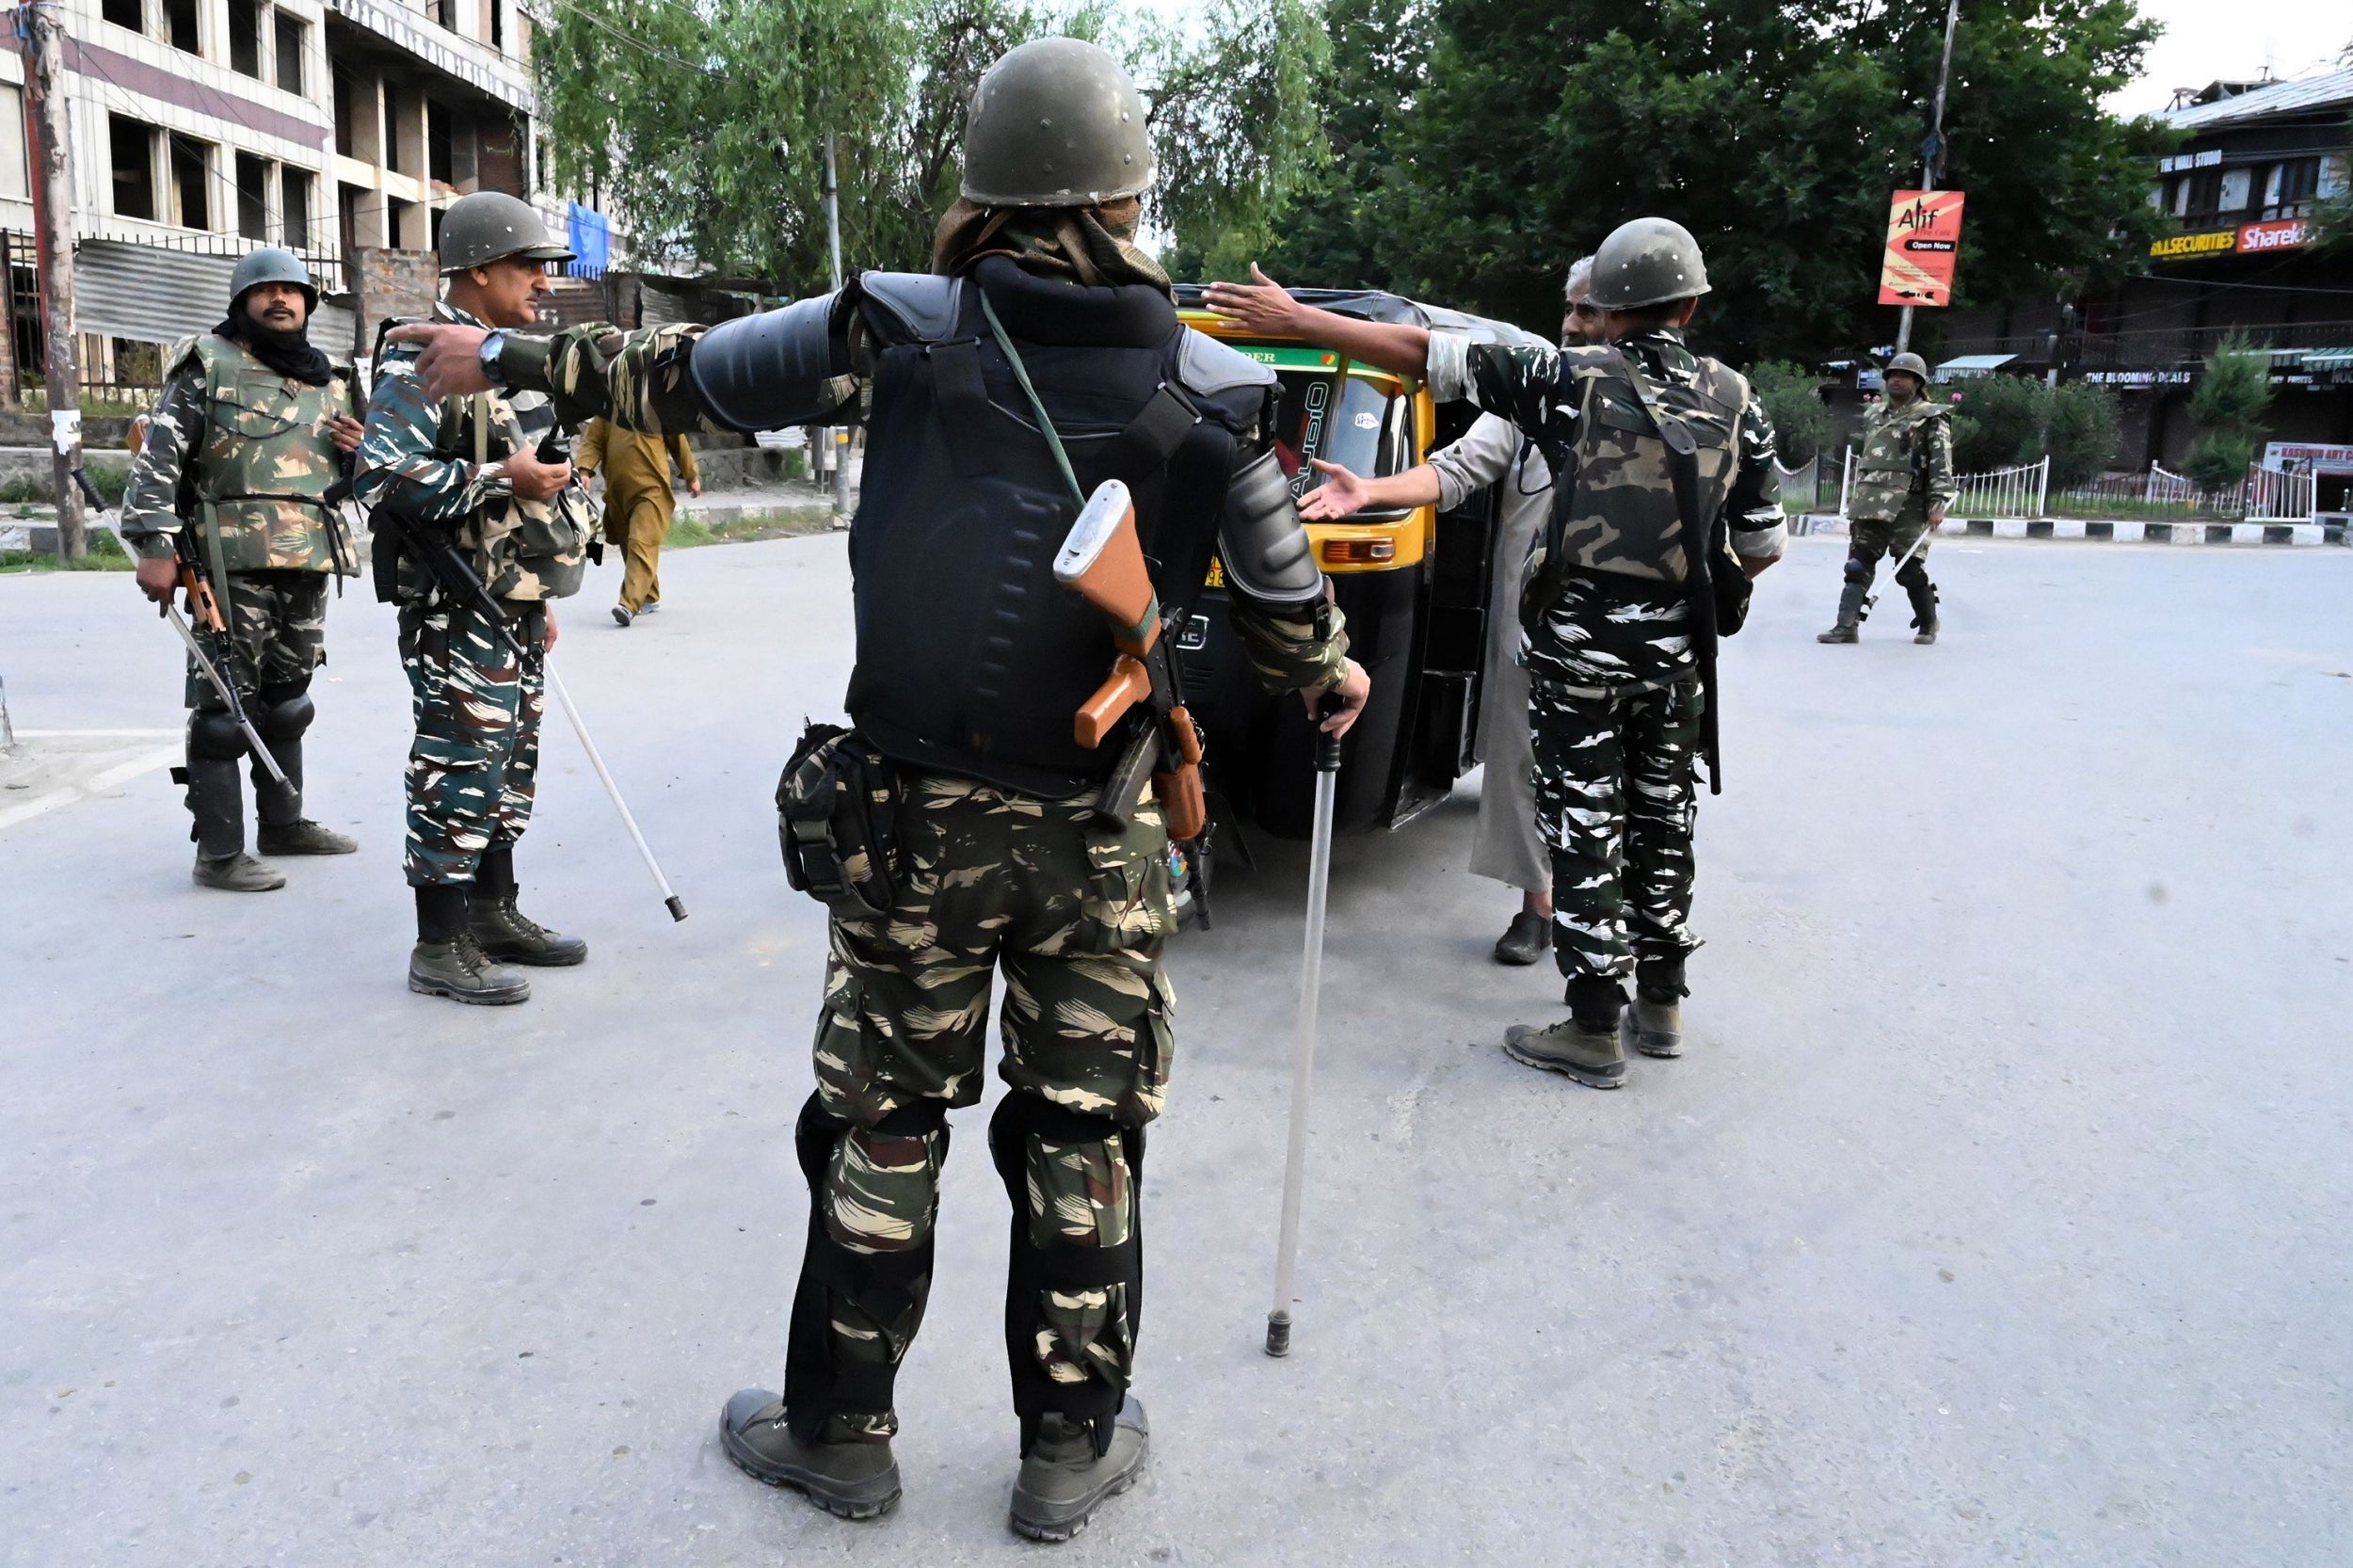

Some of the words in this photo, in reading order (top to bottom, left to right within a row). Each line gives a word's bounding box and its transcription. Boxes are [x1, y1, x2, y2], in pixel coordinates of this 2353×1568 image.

[1898, 198, 1939, 235] Alif
[1912, 241, 1931, 250] Open
[1934, 242, 1951, 250] Now
[2086, 372, 2105, 383] THE
[1289, 382, 1329, 501] AUDIO
